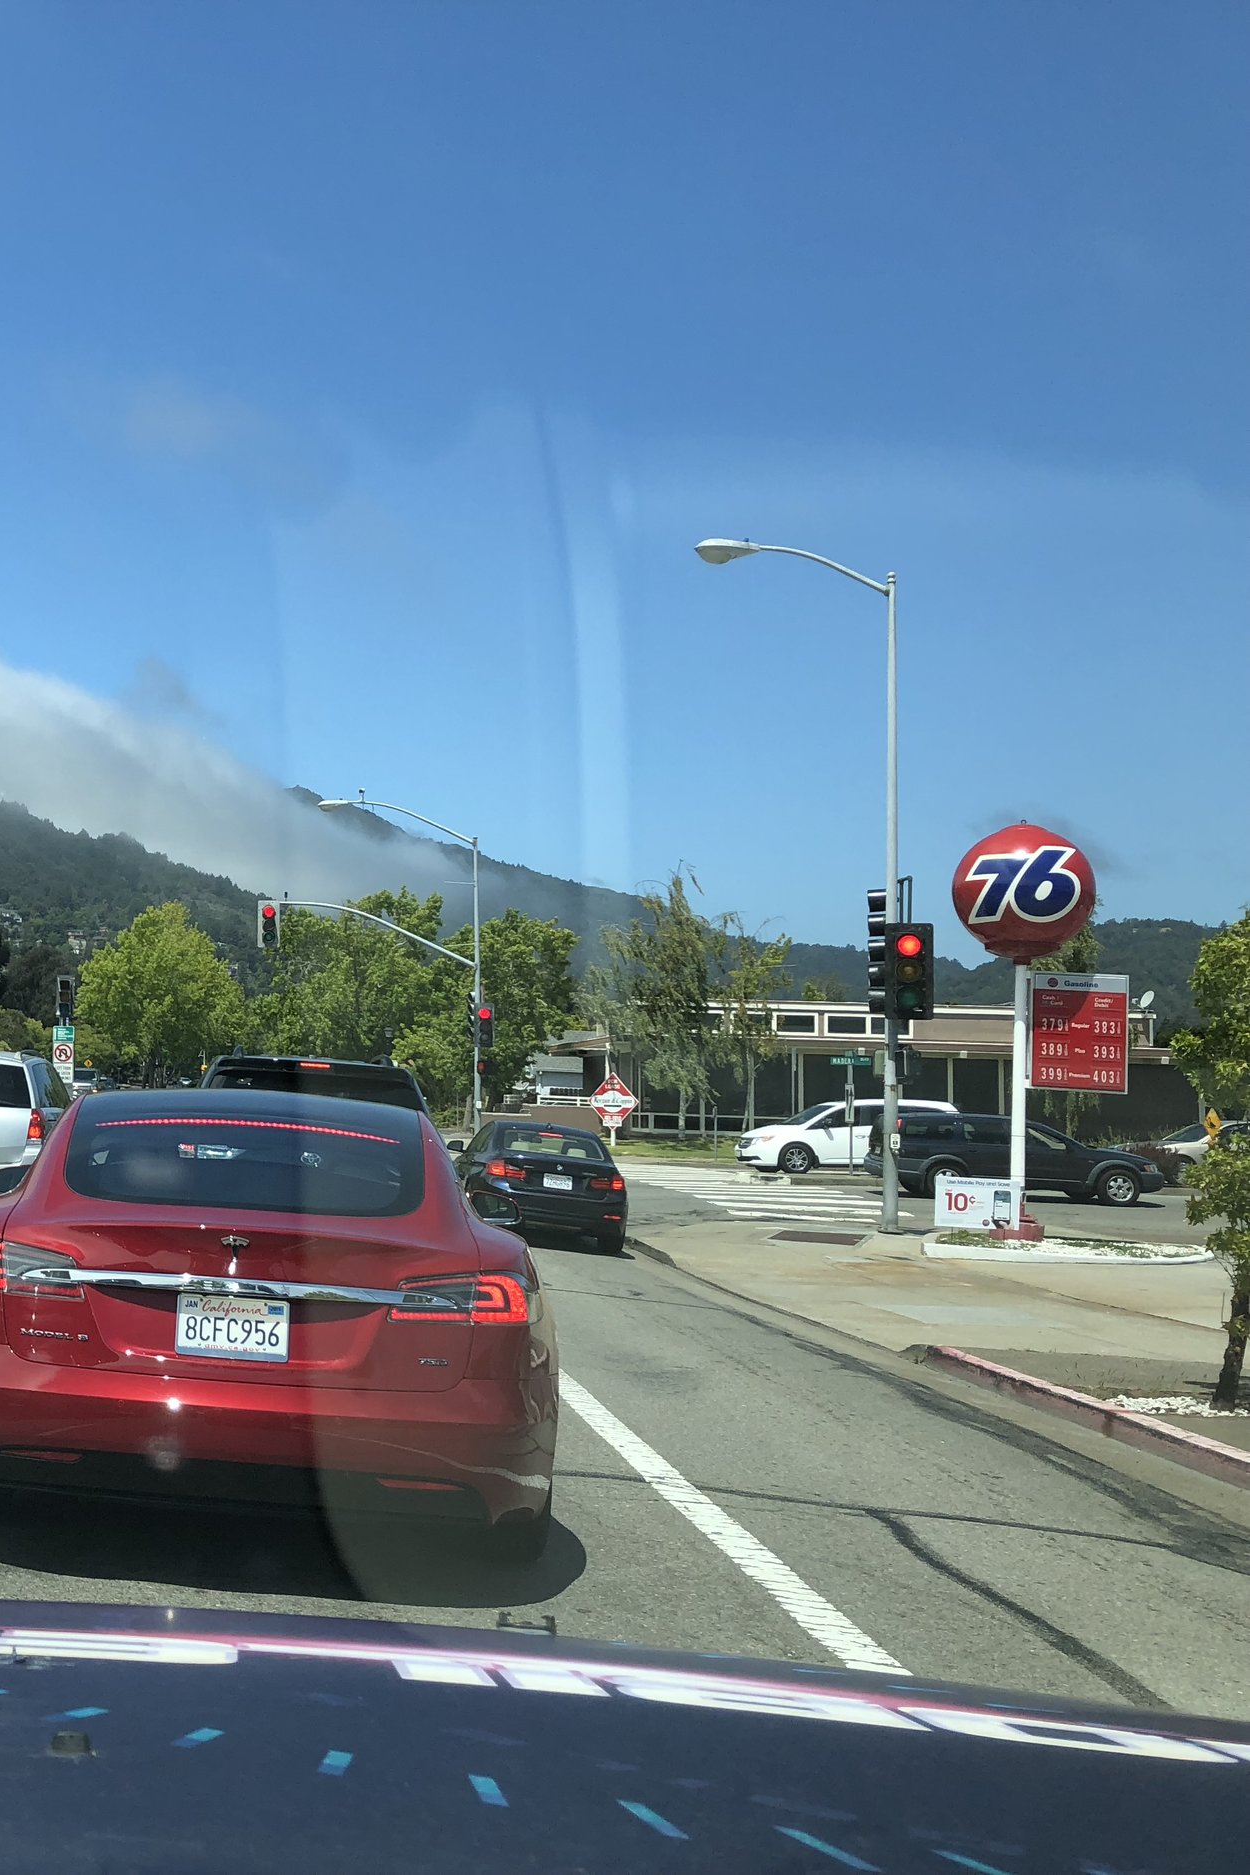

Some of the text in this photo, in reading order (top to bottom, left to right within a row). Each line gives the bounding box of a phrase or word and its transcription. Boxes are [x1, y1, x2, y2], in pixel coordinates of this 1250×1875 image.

[964, 846, 1082, 925] 76
[1064, 980, 1099, 989] Gasoline
[185, 1300, 199, 1308] JAN
[202, 1299, 268, 1317] California
[20, 1328, 74, 1341] MODEL
[185, 1316, 280, 1347] 8CFC956
